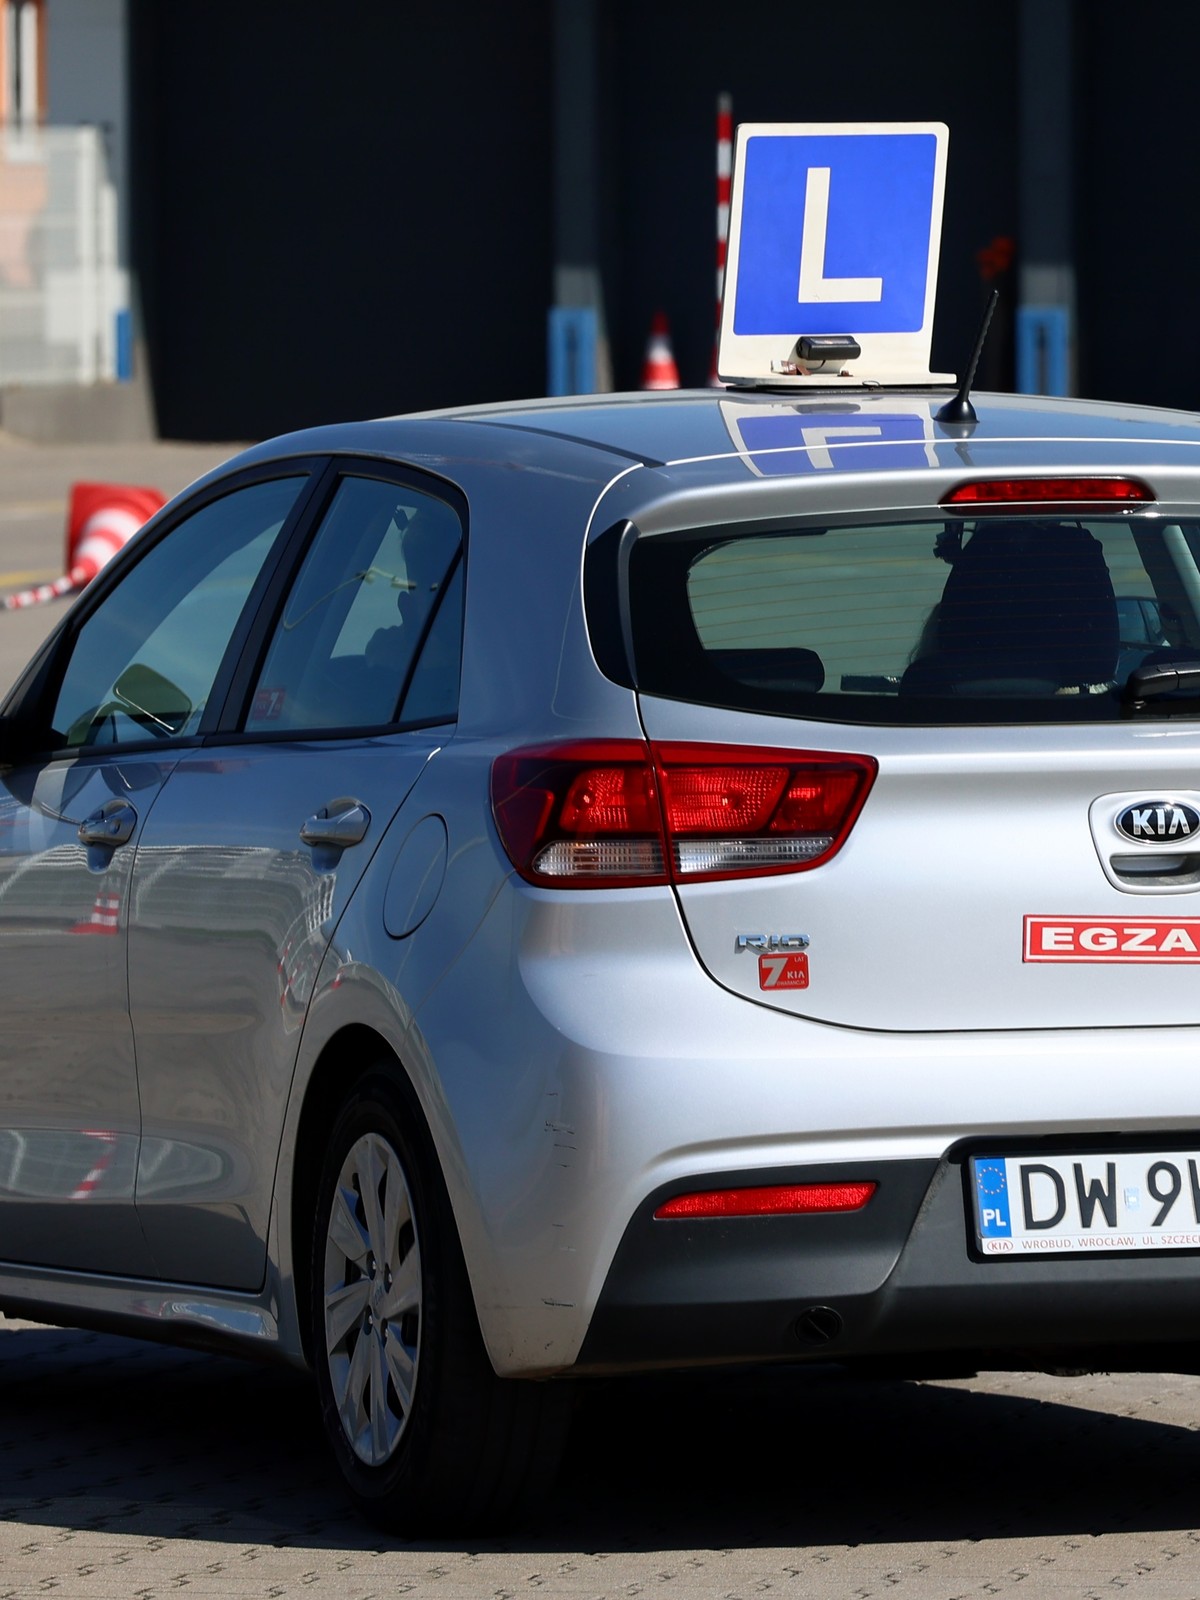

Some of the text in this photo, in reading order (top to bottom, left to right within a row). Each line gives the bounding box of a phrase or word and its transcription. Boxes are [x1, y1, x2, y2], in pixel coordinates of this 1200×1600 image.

[798, 167, 882, 303] L
[1131, 808, 1191, 835] KIA
[737, 934, 810, 952] RIO
[761, 957, 788, 987] 7
[787, 971, 805, 979] KIA
[1020, 1162, 1118, 1230] DW
[982, 1208, 1007, 1227] PL
[1022, 1239, 1074, 1249] WROBUD,
[1077, 1237, 1137, 1248] WROCŁAW,
[1142, 1236, 1158, 1245] UL.
